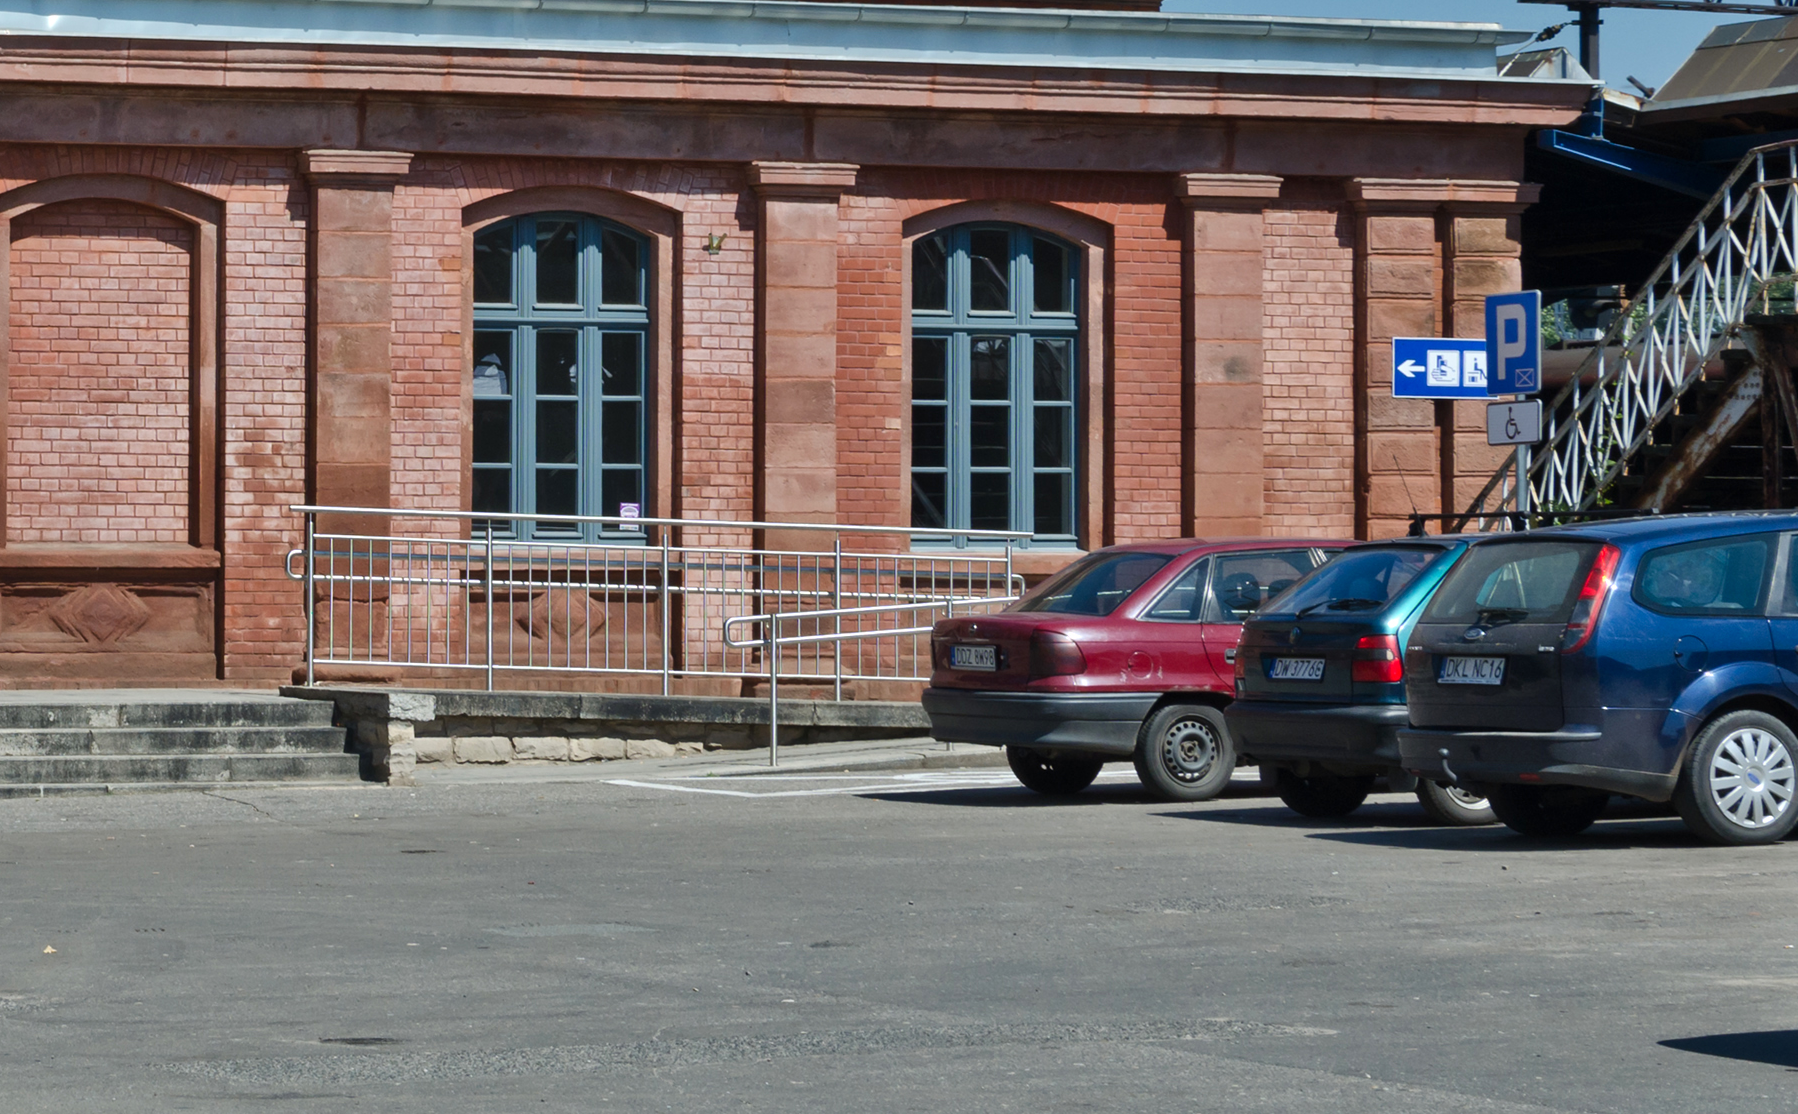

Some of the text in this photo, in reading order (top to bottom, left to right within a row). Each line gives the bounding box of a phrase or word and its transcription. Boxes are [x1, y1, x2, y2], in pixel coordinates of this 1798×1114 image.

[1496, 303, 1527, 381] P
[956, 648, 973, 665] DDZ
[1274, 659, 1291, 676] DW
[1446, 658, 1503, 678] DKL NC16
